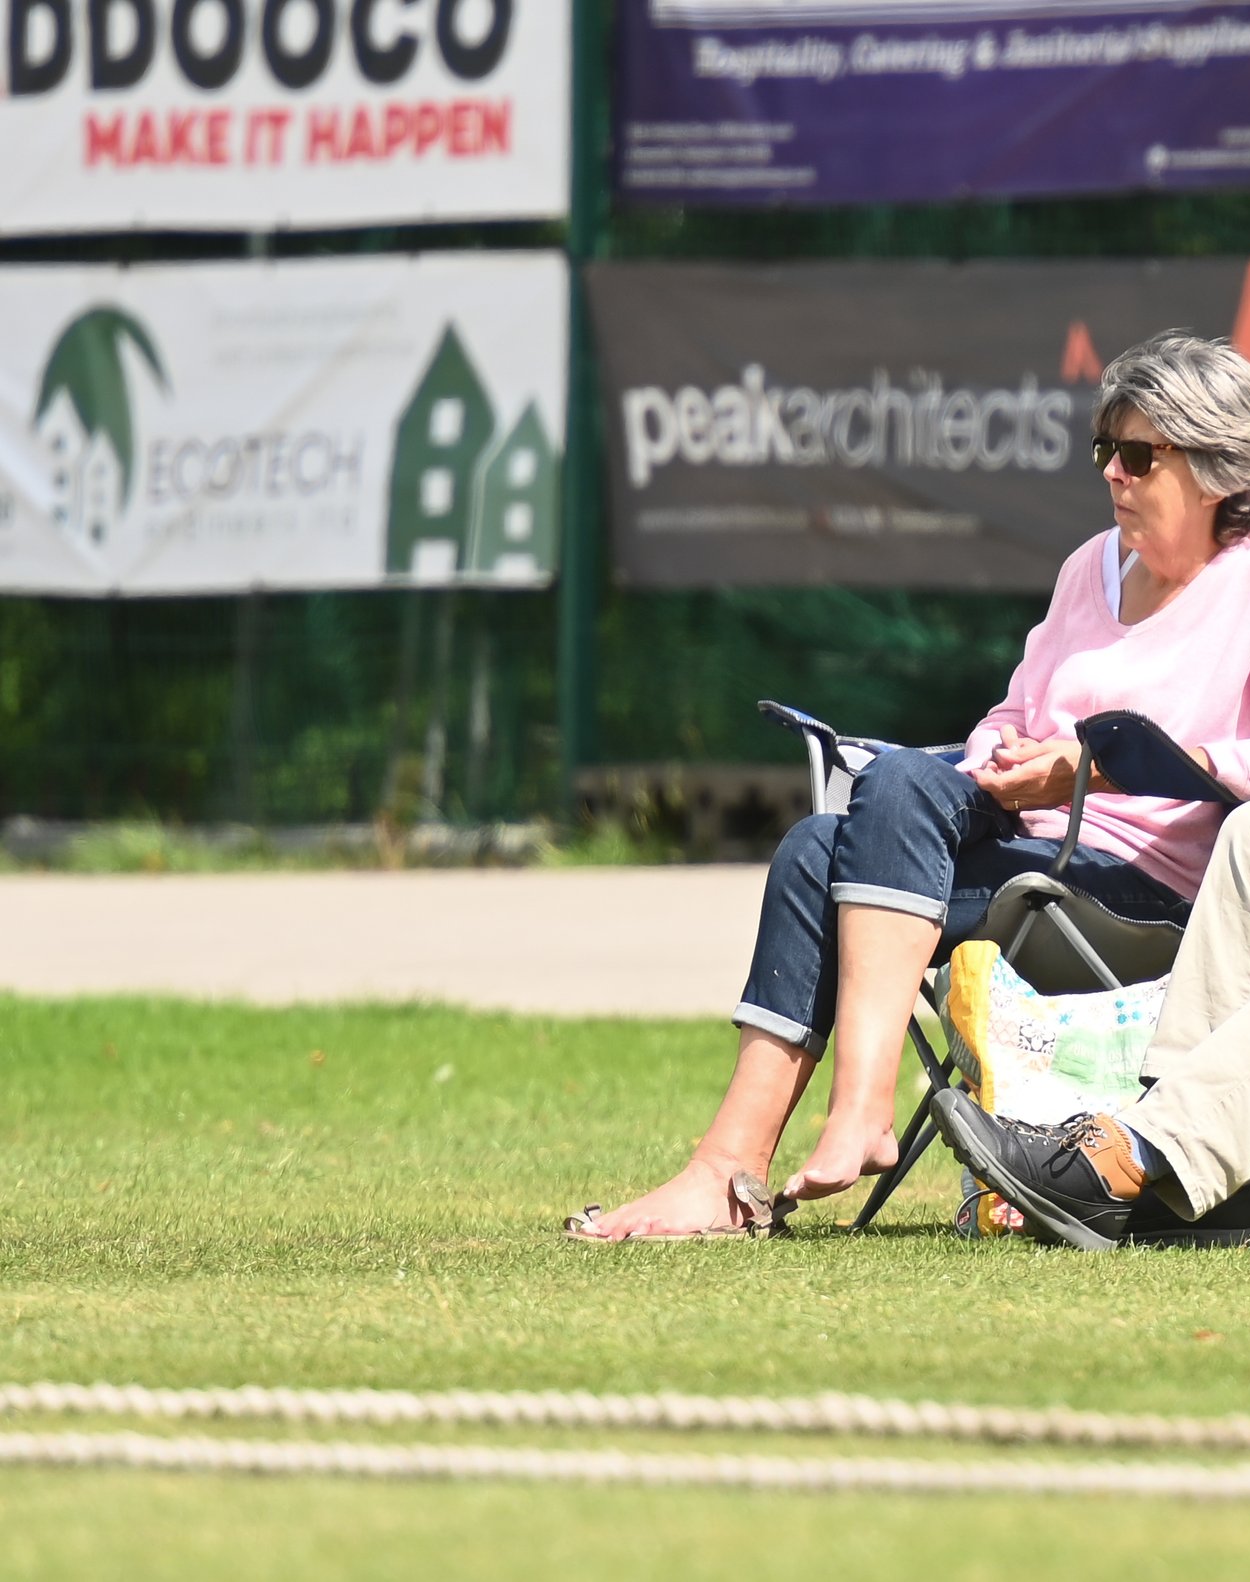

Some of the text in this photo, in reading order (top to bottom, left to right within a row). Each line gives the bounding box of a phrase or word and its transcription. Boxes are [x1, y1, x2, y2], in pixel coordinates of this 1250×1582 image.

[0, 0, 517, 97] DDOOCO
[85, 99, 512, 168] MAKE IT HAPPEN
[146, 429, 366, 503] ECOTECH
[622, 362, 1075, 489] peakarchitects
